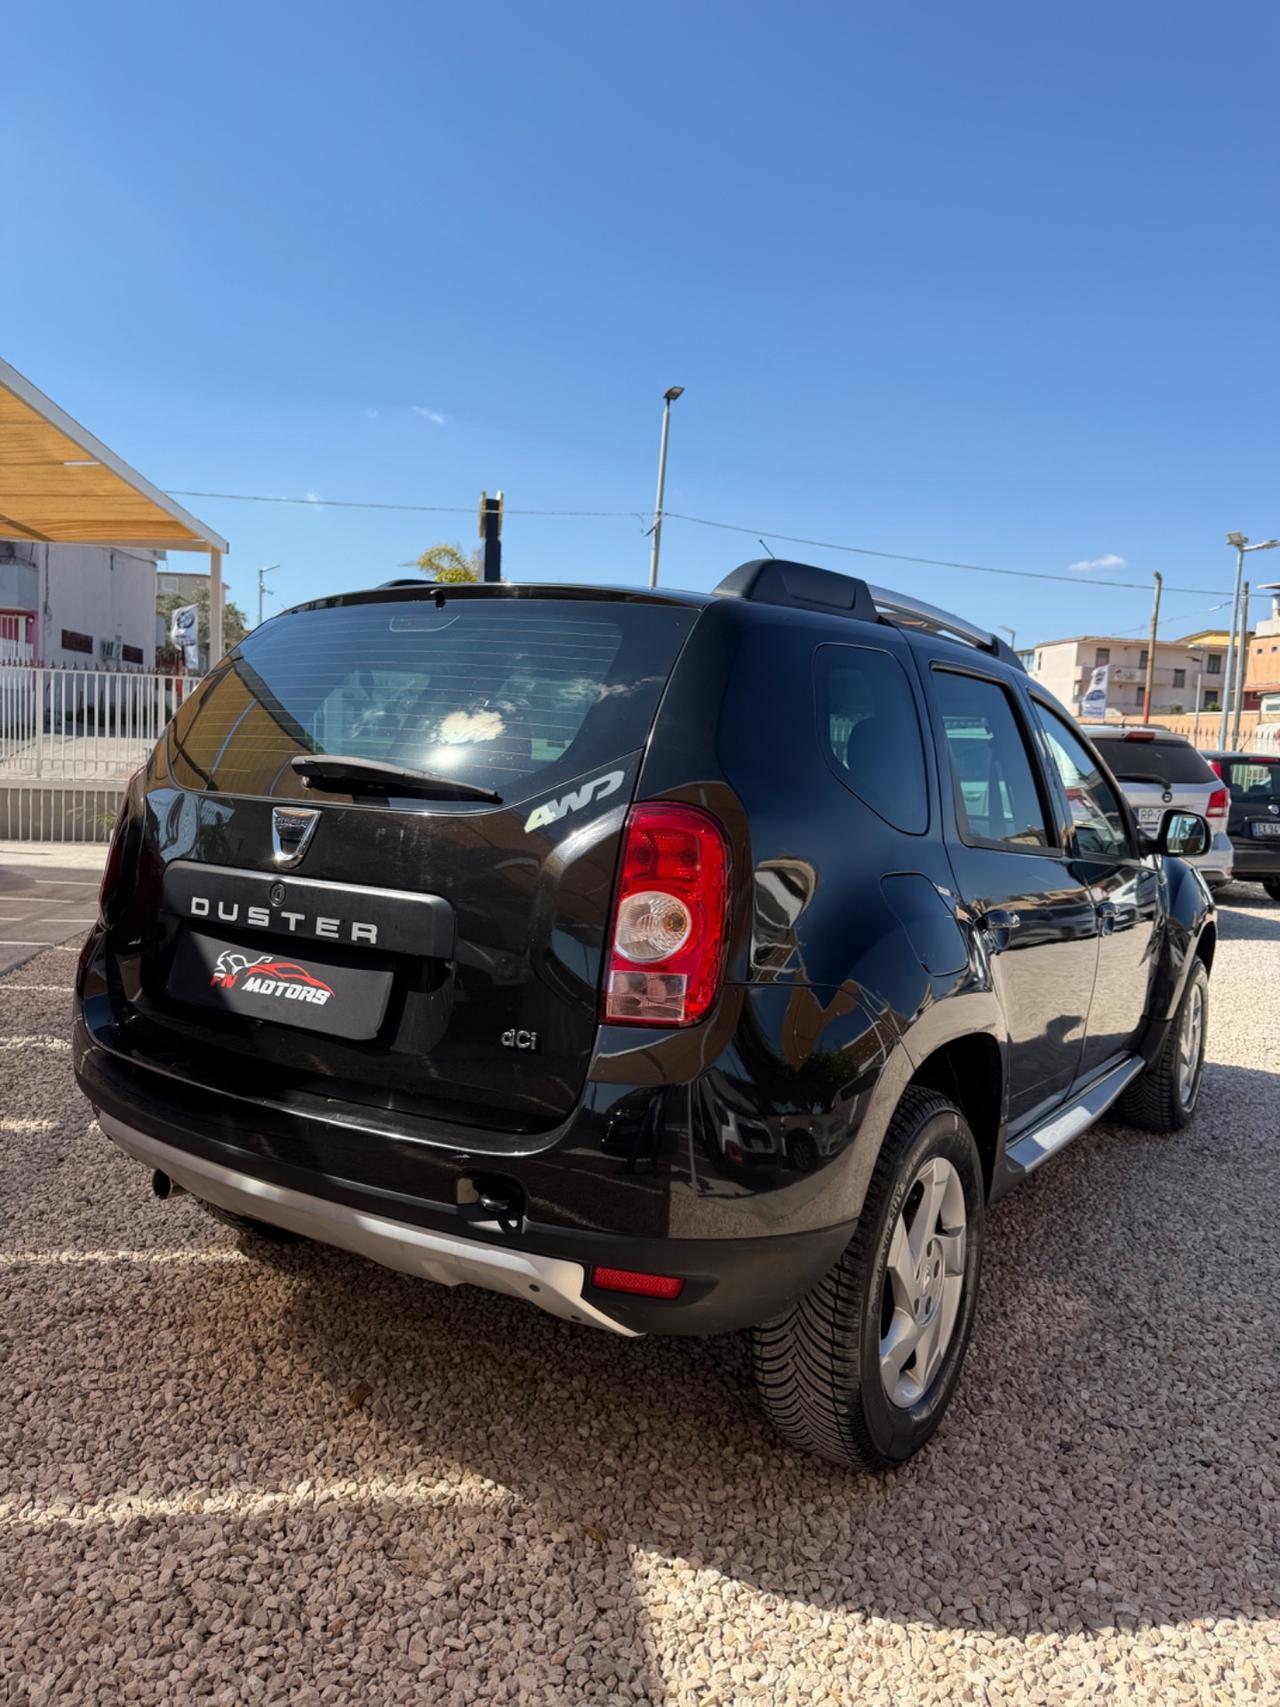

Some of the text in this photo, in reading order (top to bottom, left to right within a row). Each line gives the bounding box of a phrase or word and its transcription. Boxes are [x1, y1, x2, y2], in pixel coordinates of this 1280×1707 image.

[524, 770, 625, 834] 4WD
[190, 896, 379, 945] DUSTER
[241, 977, 331, 1006] MOTORS
[500, 1028, 537, 1051] dCi
